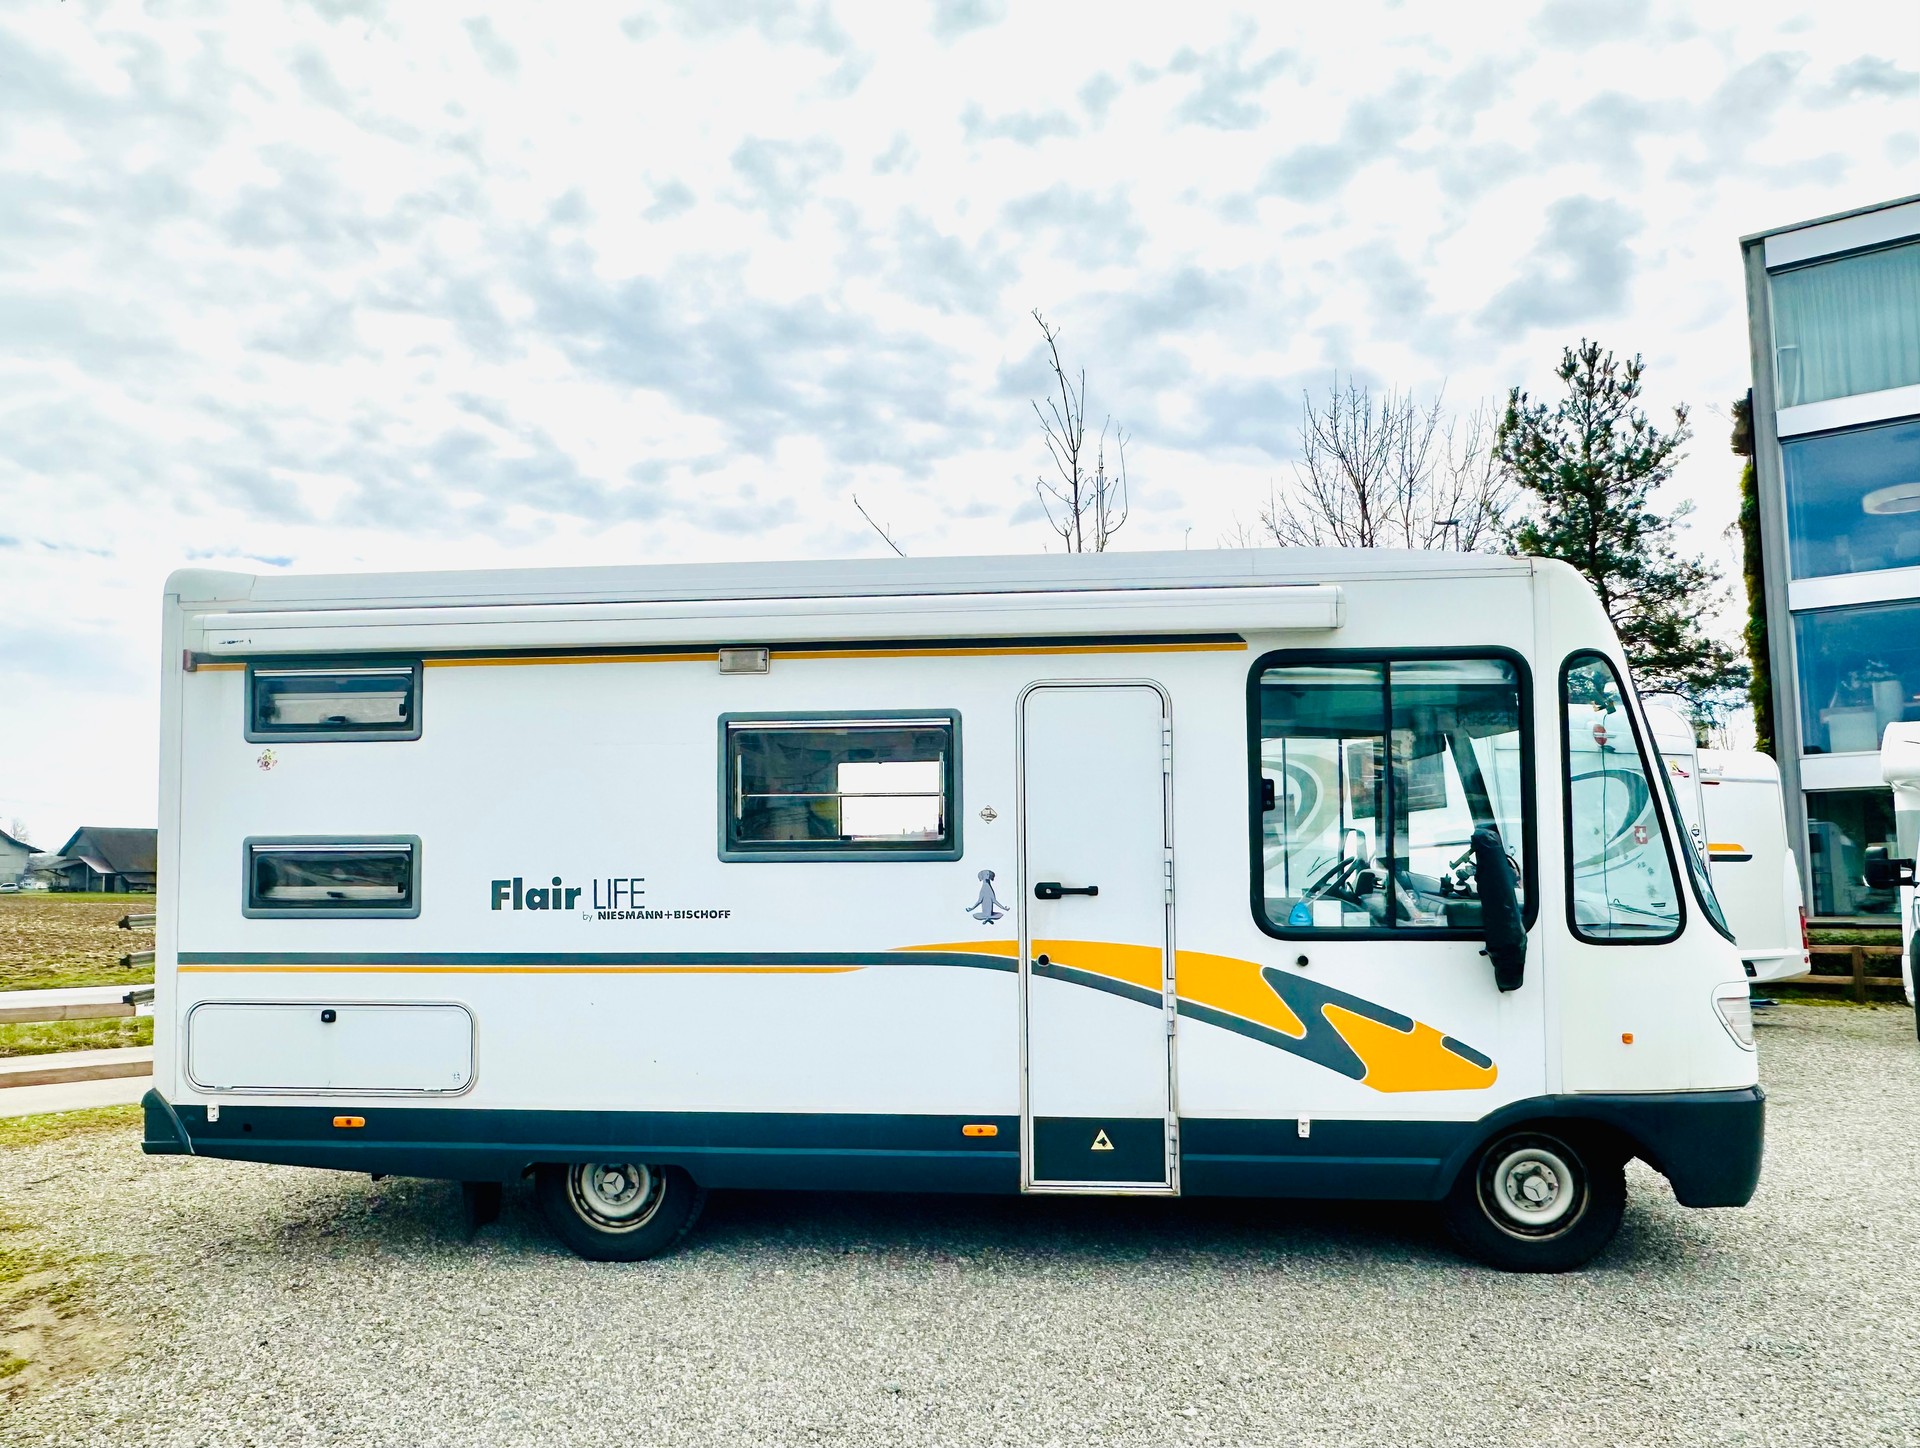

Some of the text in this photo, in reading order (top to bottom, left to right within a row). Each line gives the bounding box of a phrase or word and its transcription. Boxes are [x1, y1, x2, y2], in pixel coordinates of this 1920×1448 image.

[490, 876, 646, 911] Flair LIFE
[582, 909, 731, 922] by NIESMANN+BISCHOFF
